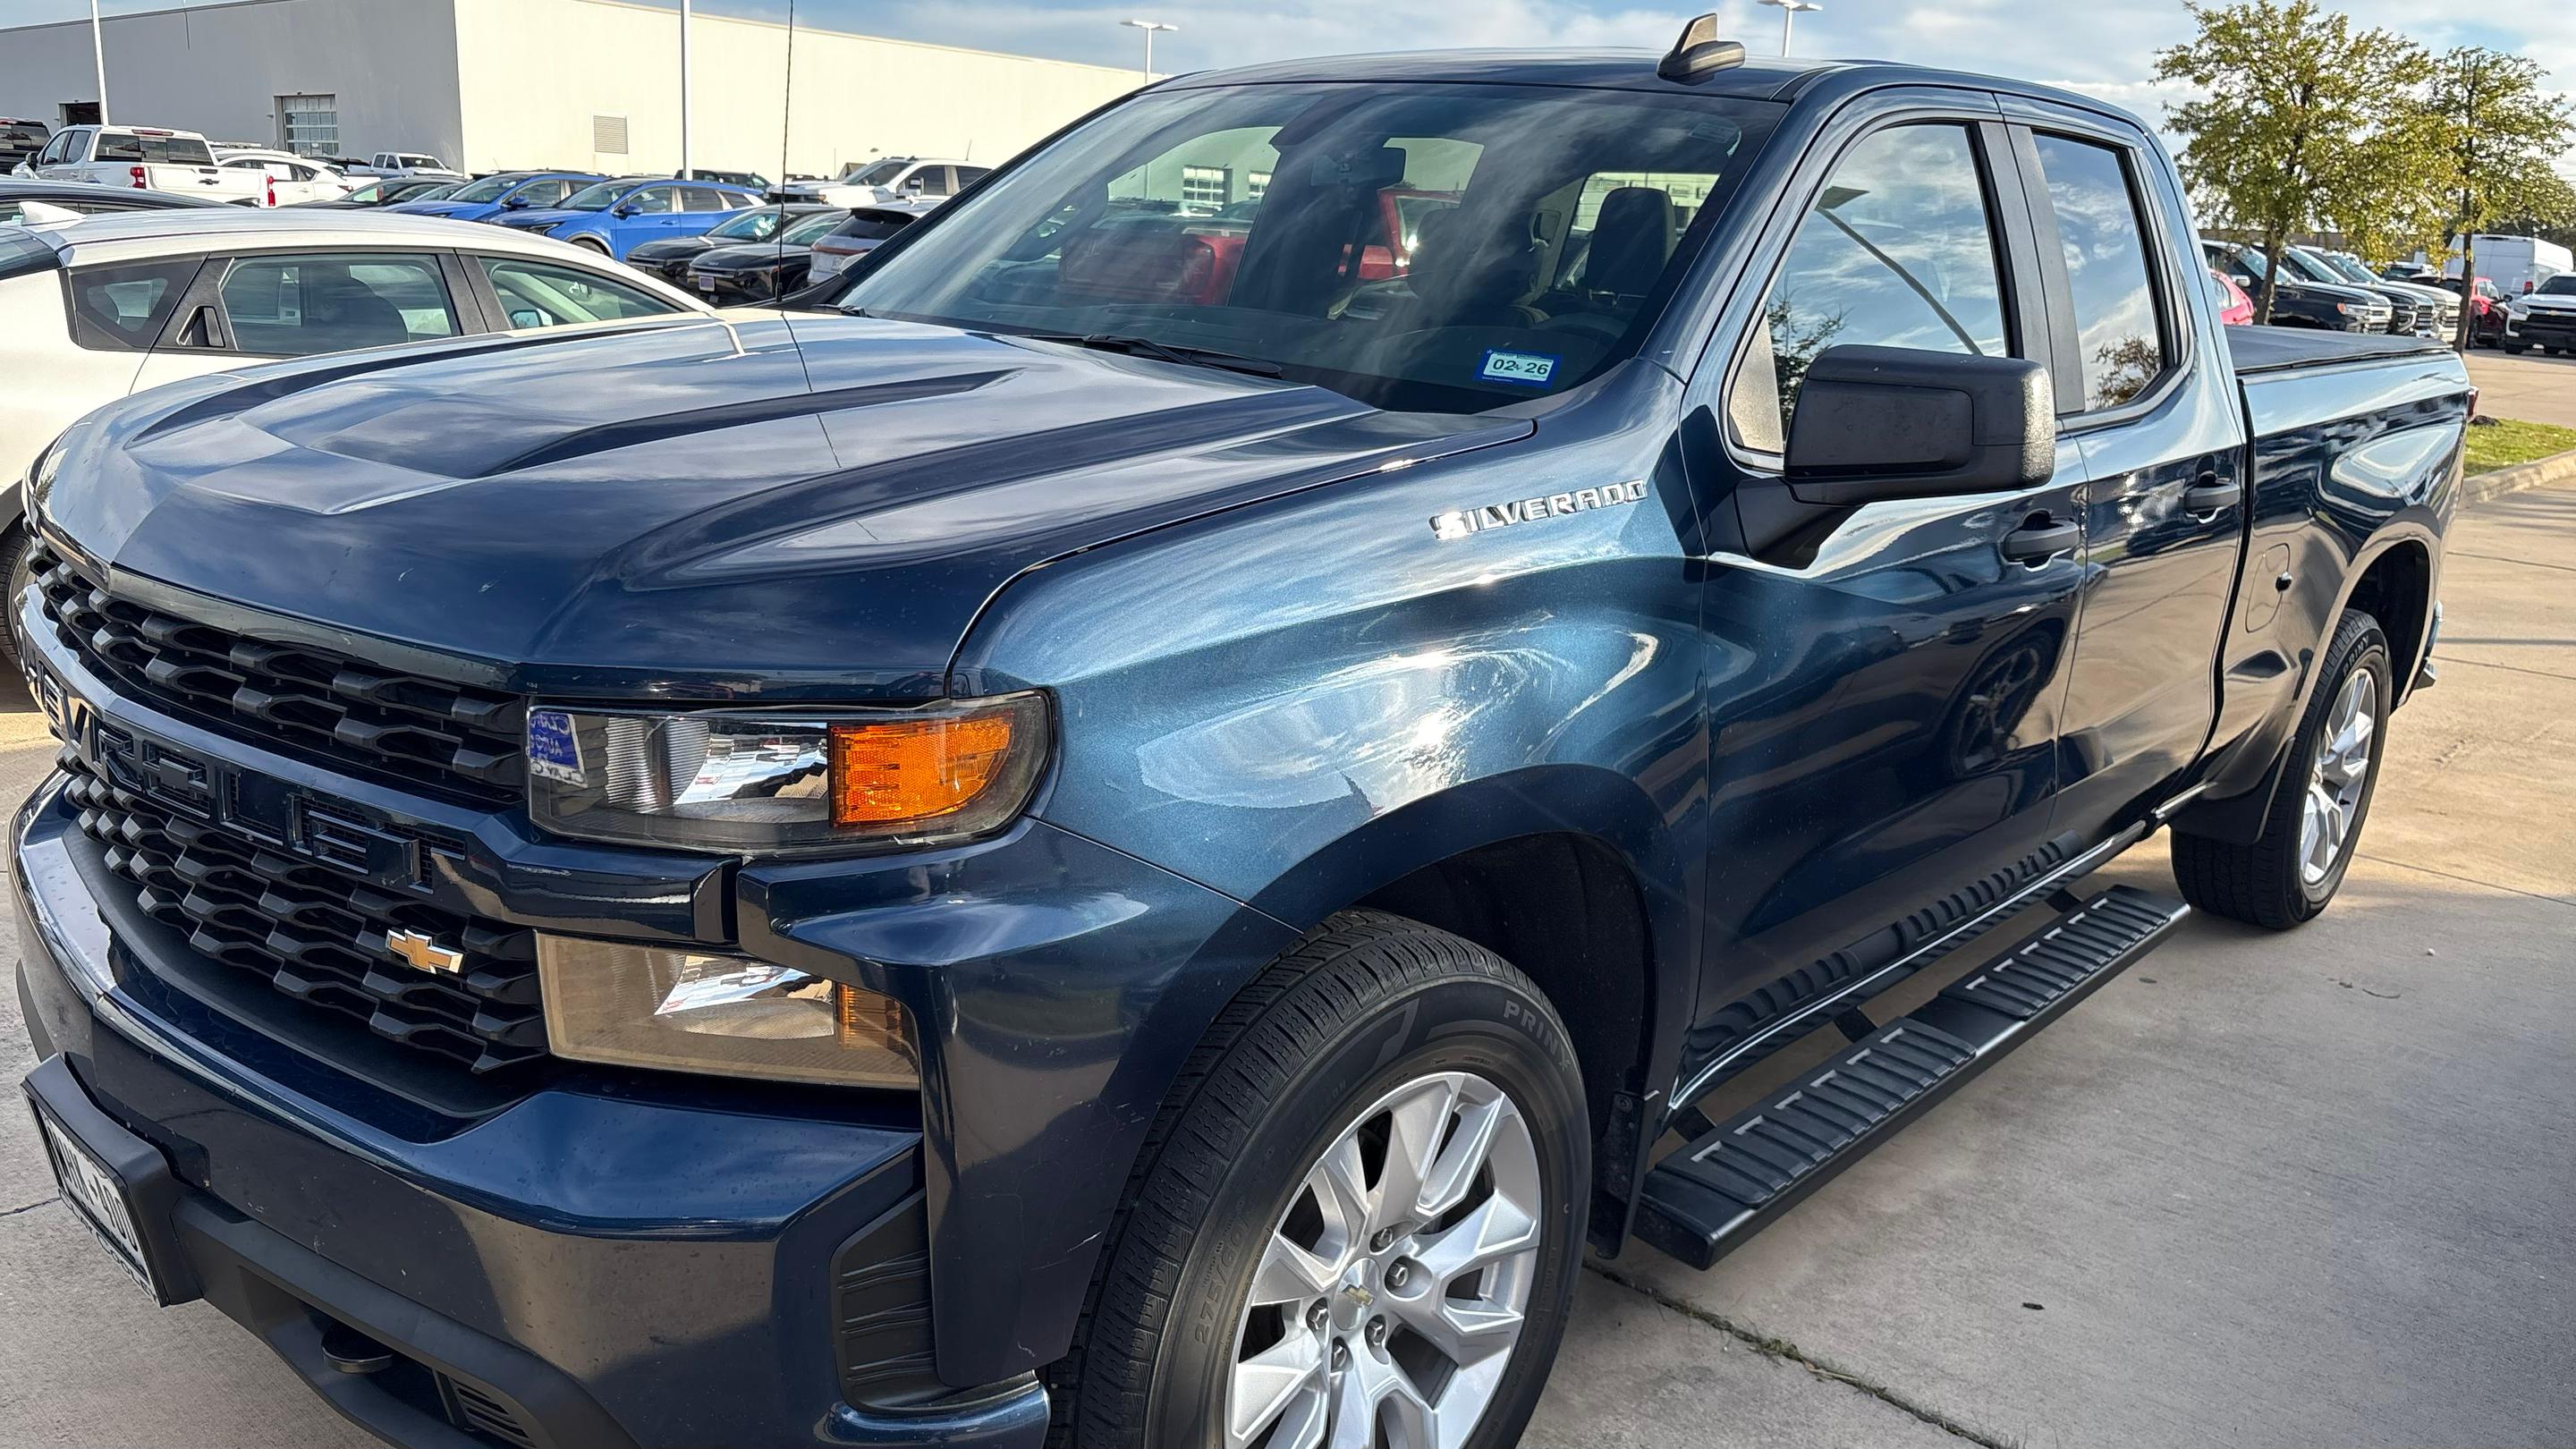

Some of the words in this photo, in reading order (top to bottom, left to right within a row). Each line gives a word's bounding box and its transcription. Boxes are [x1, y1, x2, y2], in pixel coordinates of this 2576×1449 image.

[1493, 359, 1517, 371] 02
[1524, 362, 1549, 375] 26
[1429, 479, 1648, 540] SILVERADO
[18, 623, 466, 895] HEVROLET
[1503, 998, 1572, 1072] PRINX
